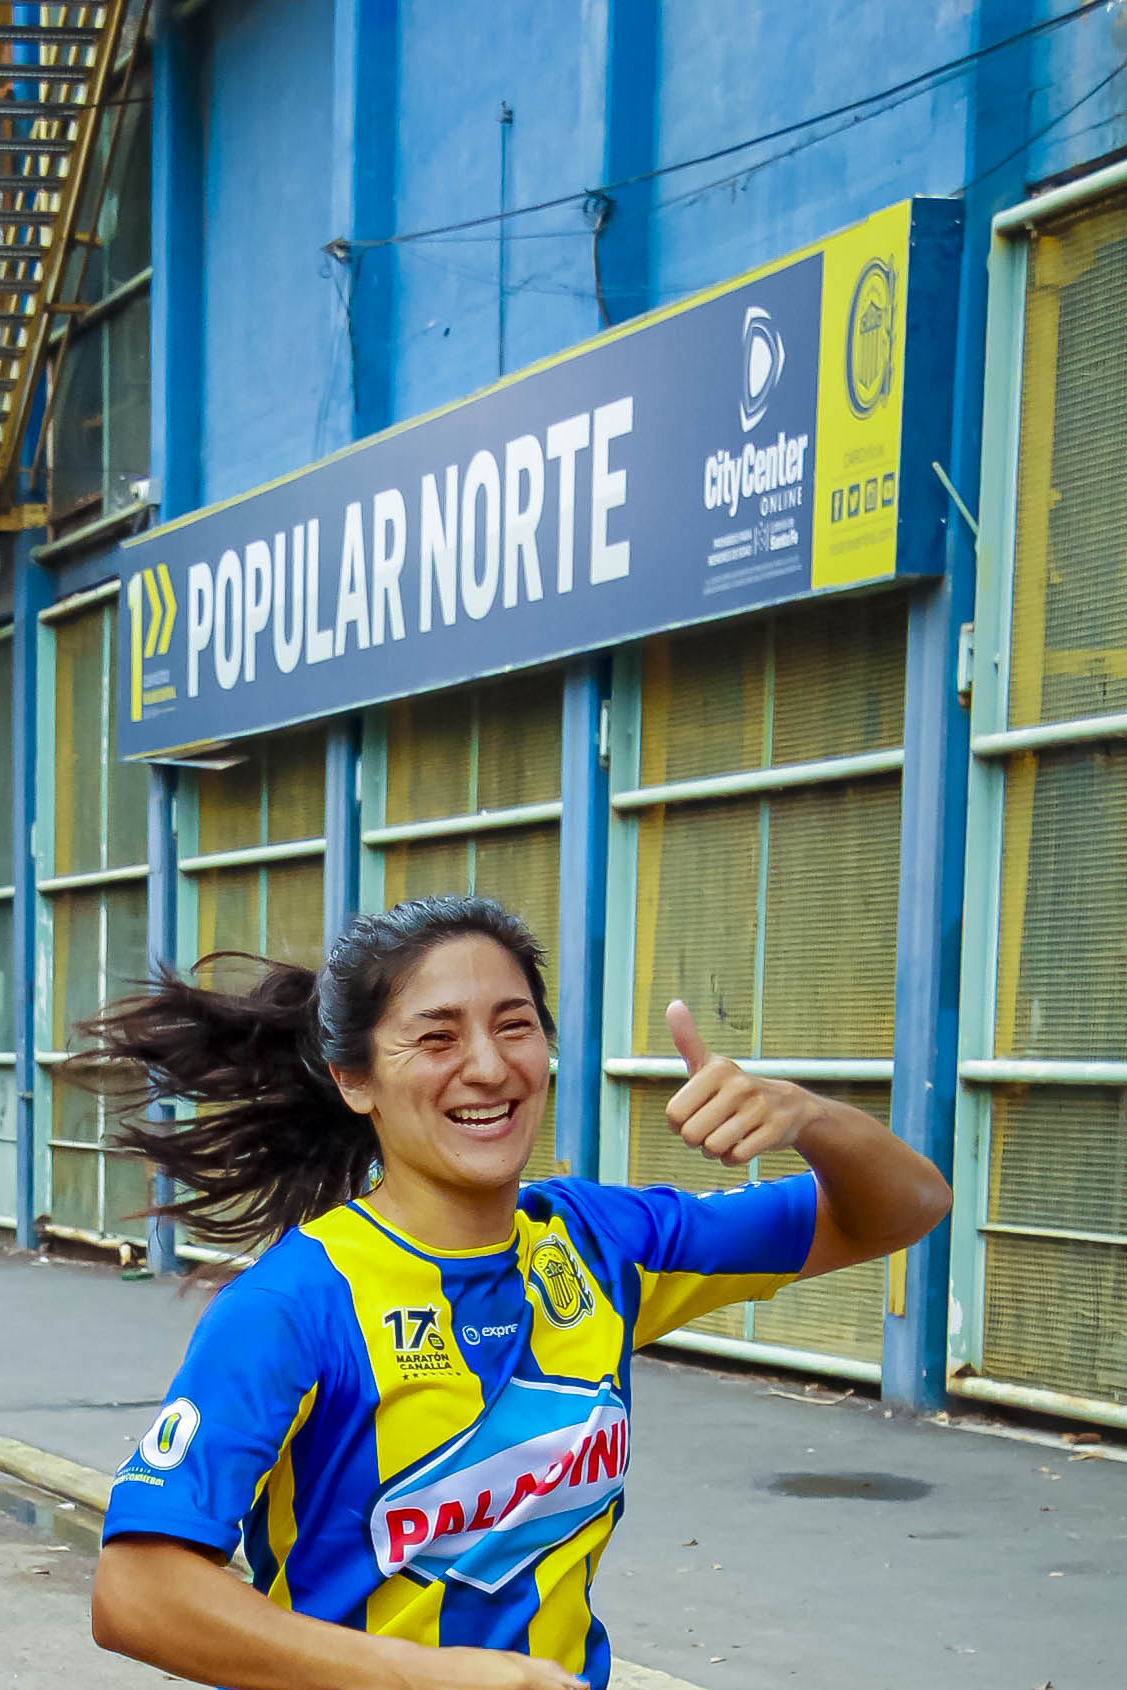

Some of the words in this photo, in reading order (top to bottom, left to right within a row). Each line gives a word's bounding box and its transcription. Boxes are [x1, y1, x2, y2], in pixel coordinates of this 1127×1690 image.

[760, 486, 803, 517] ONLINE
[187, 488, 407, 698] POPULAR
[419, 396, 634, 633] NORTE
[382, 1303, 442, 1352] 17
[396, 1352, 449, 1364] MARATÓN
[400, 1362, 453, 1371] CANALLA
[386, 1418, 627, 1563] PALADINI
